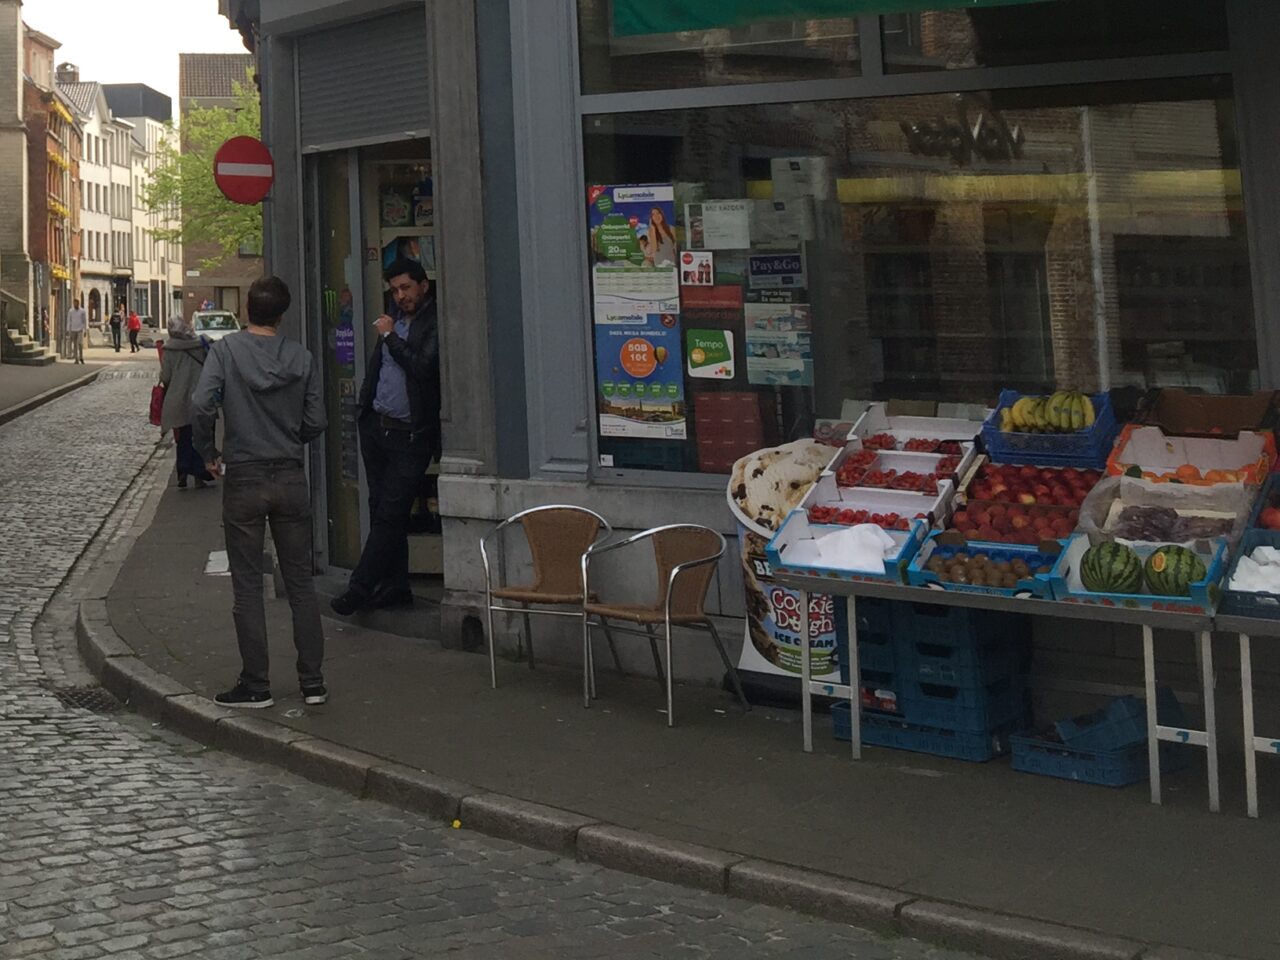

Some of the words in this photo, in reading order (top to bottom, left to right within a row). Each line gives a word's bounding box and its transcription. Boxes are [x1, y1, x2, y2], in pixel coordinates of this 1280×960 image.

[751, 259, 800, 274] Pay&Go
[695, 338, 724, 350] Tempo
[776, 609, 833, 637] Dogh
[775, 631, 792, 645] ICE
[794, 637, 834, 649] CEAM
